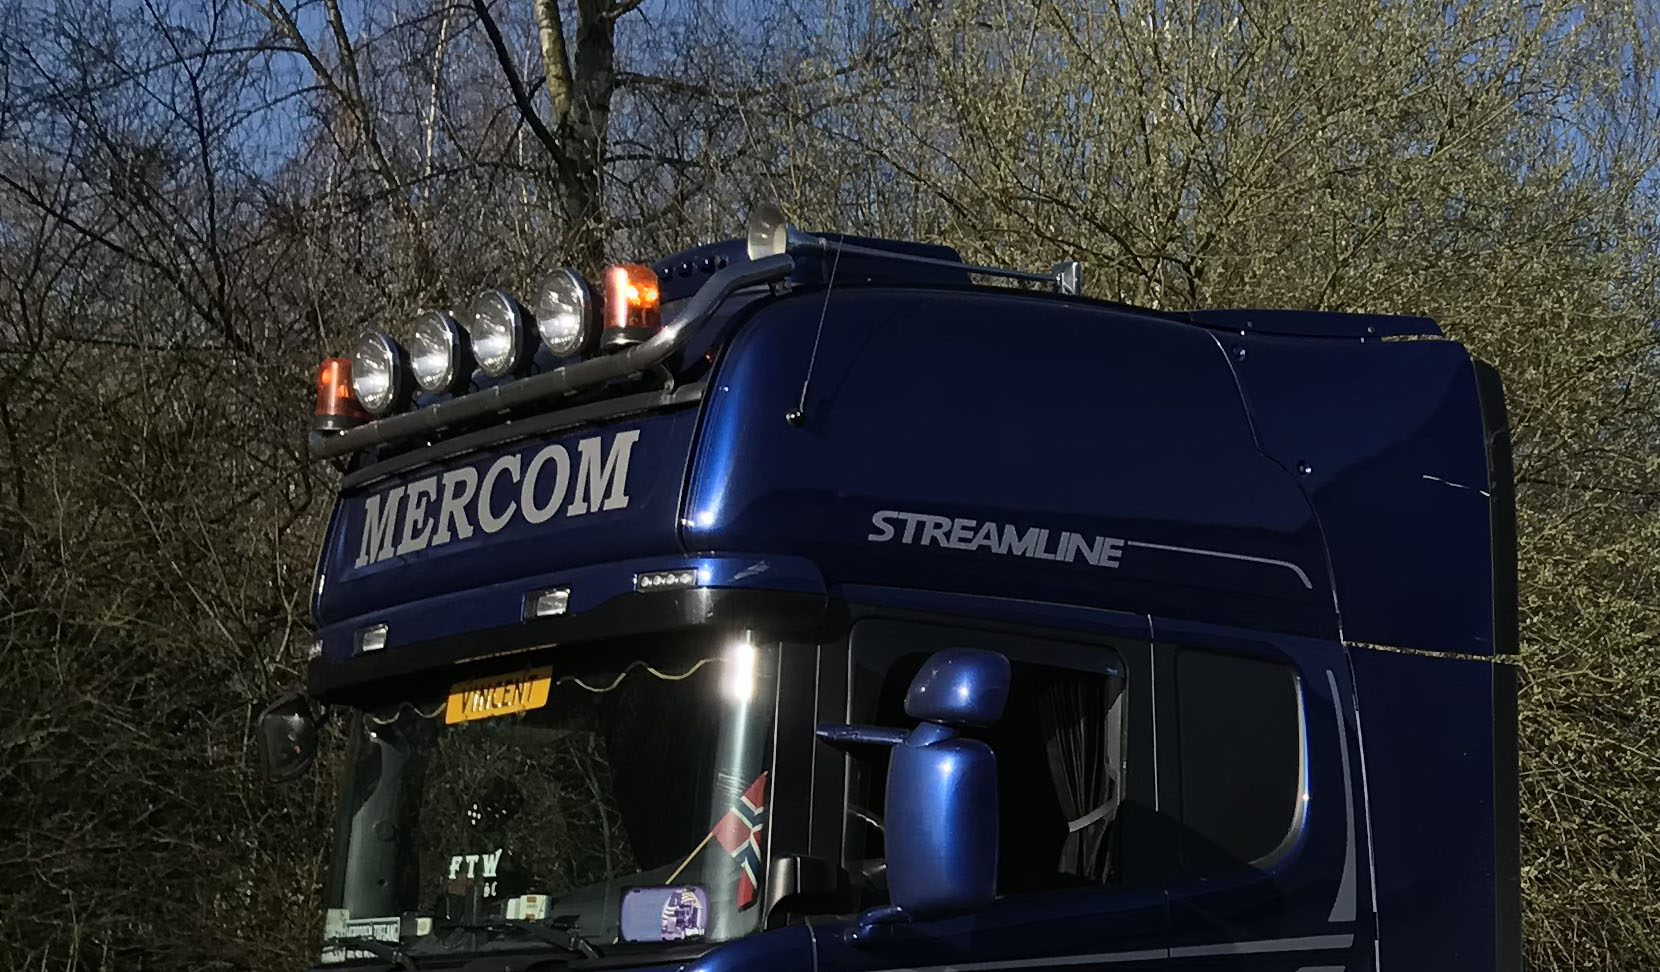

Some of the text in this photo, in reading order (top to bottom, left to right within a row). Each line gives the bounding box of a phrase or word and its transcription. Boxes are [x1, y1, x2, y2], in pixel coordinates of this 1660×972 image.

[354, 429, 640, 569] MERCOM
[868, 510, 1124, 568] STREAMLINE
[448, 848, 503, 880] FTW
